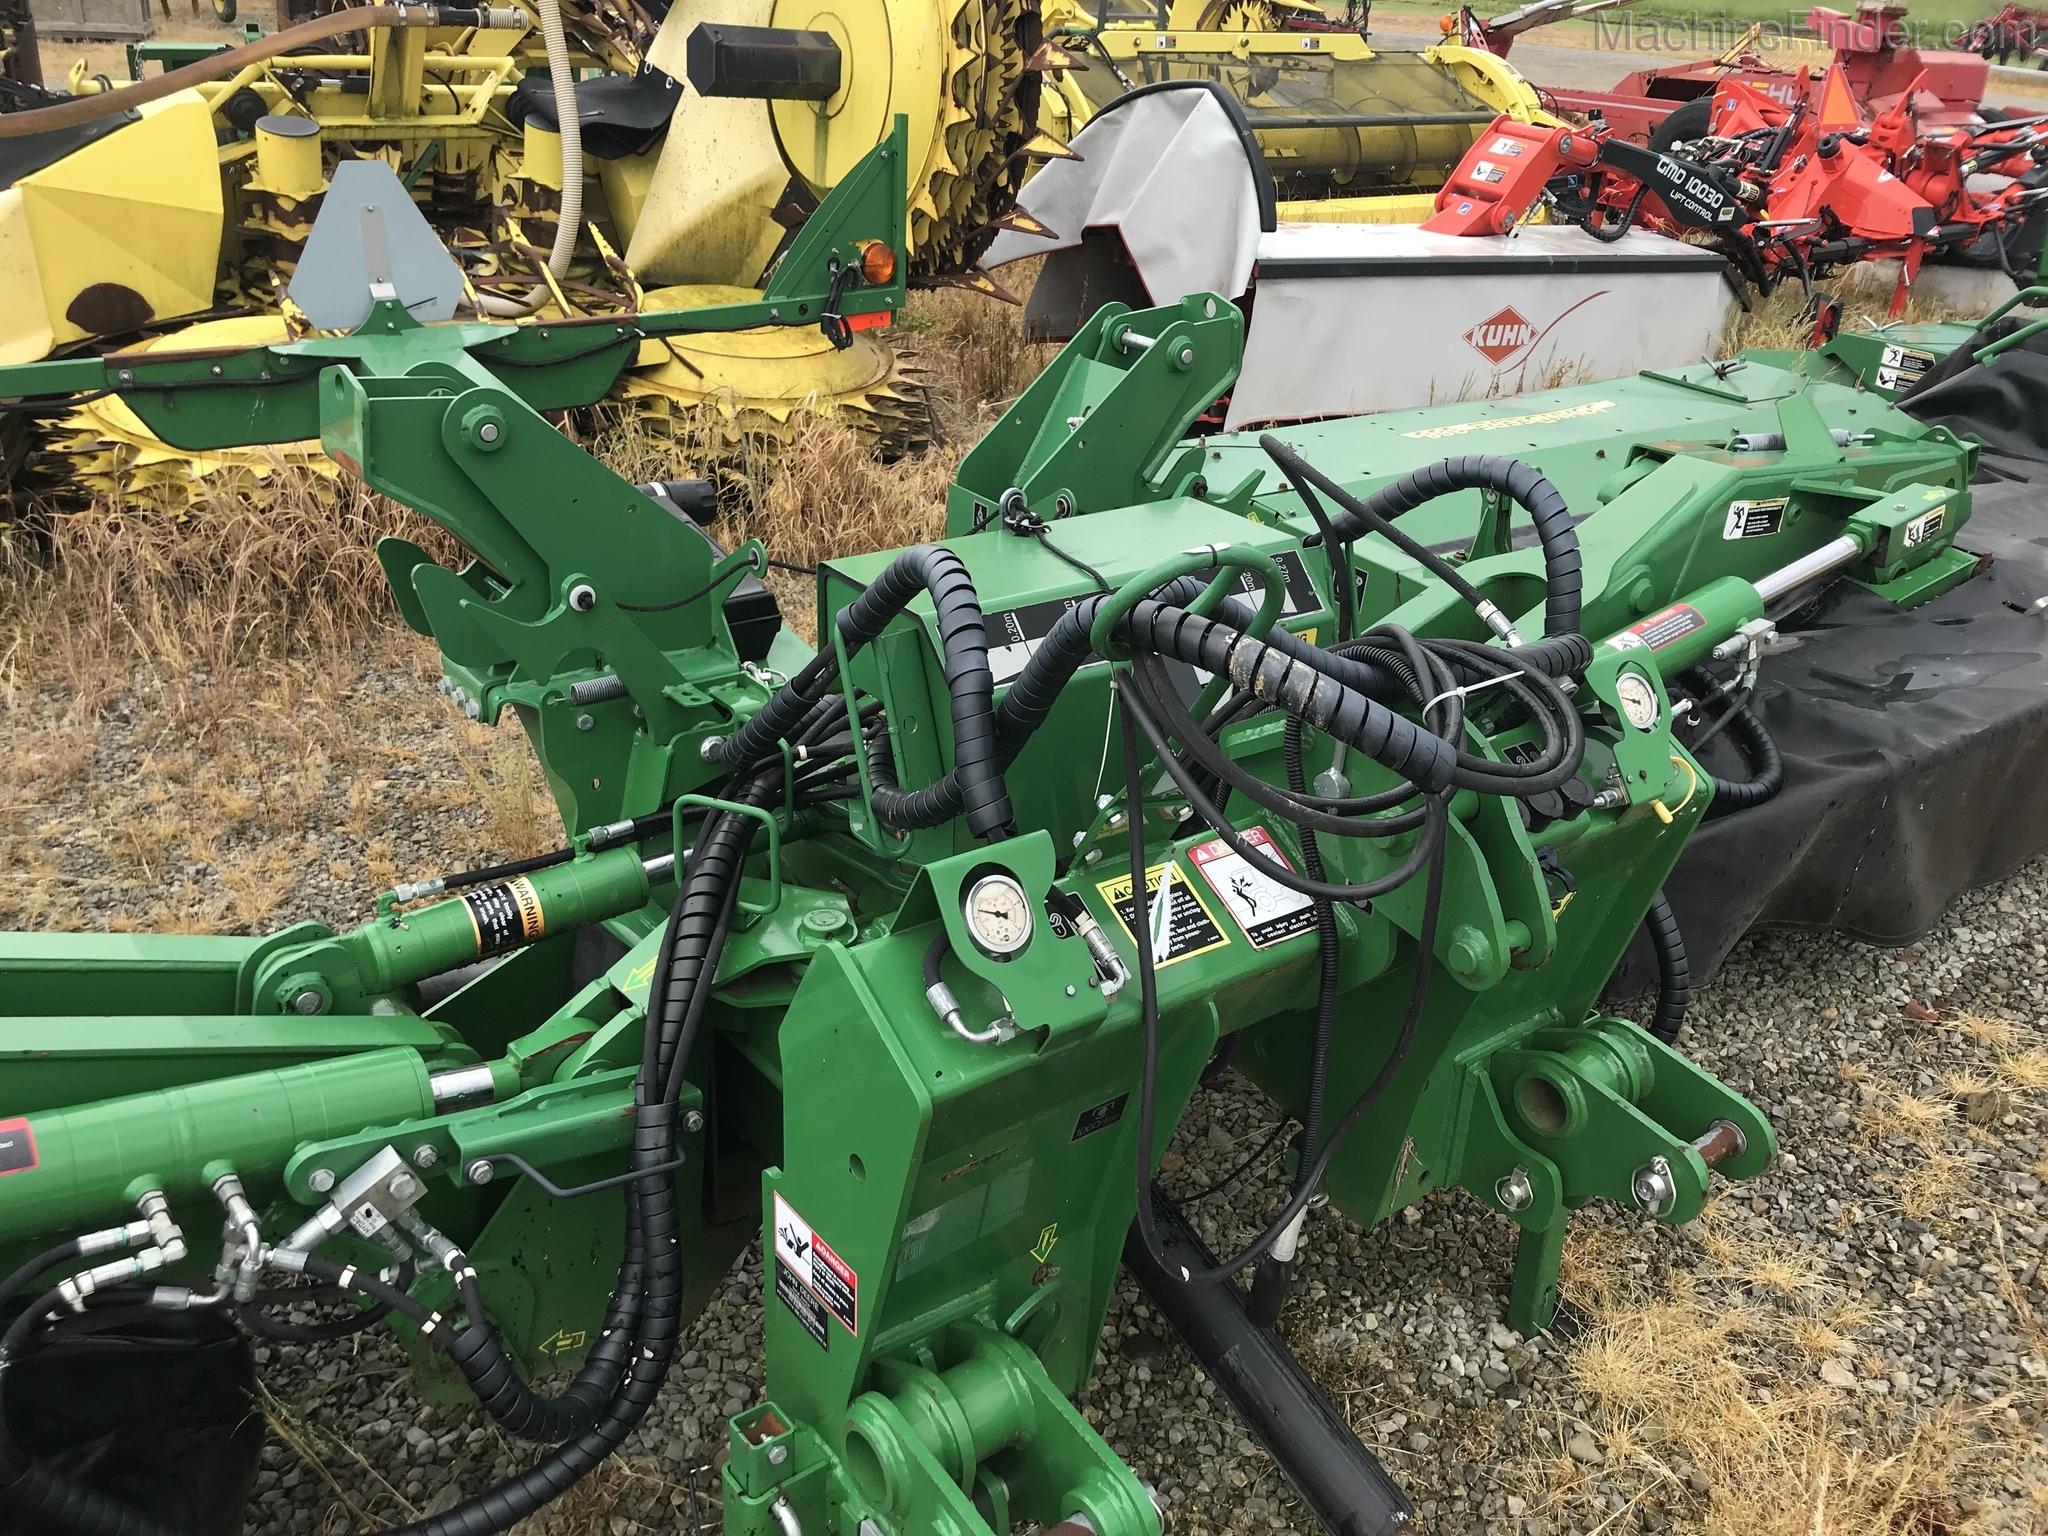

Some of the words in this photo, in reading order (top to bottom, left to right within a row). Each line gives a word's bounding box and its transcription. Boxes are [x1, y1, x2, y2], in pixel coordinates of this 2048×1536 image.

[1656, 157, 1687, 185] GMD
[1684, 176, 1724, 209] 10030
[1669, 189, 1688, 203] LIFT
[1683, 198, 1713, 222] CONTROL
[1470, 323, 1534, 348] KUHN
[1003, 612, 1020, 642] 0.20m
[1208, 829, 1264, 856] DAER
[513, 881, 540, 939] WARNING
[821, 1245, 850, 1281] DANGER
